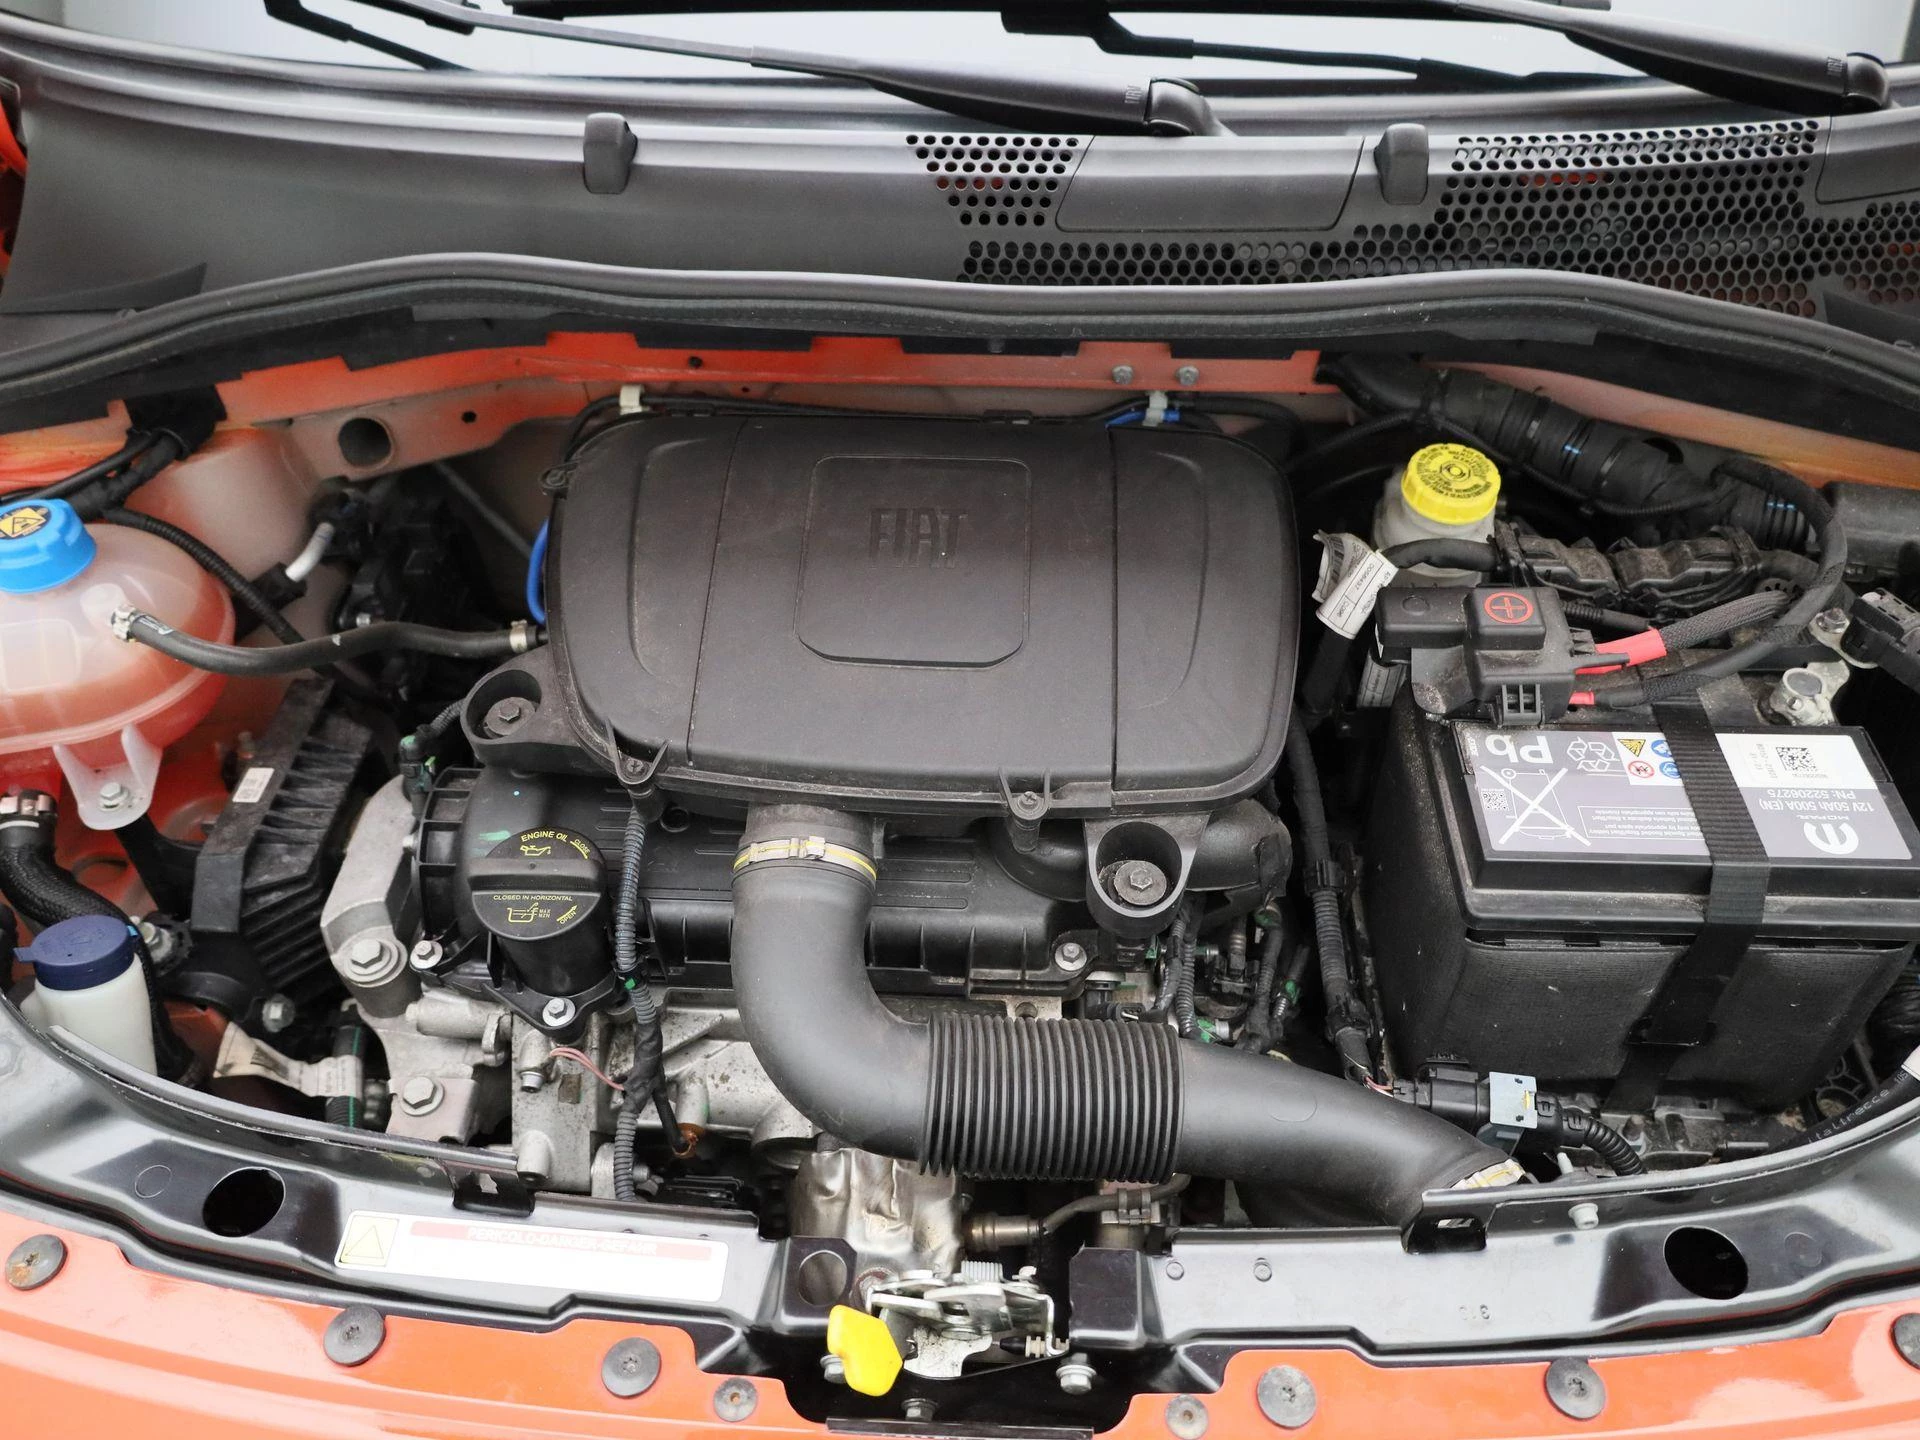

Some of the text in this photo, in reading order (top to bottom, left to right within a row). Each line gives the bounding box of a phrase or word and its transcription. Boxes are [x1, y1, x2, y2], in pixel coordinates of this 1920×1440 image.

[869, 508, 968, 569] FIAT
[1484, 734, 1554, 764] Pb
[1831, 789, 1856, 800] PN:
[1758, 797, 1876, 812] 12V 50Ah 500A (EN)
[520, 831, 569, 843] ENGINE OIL
[574, 839, 591, 854] CLOSE
[530, 894, 573, 902] HORIZONTAL
[559, 911, 577, 925] OPEN
